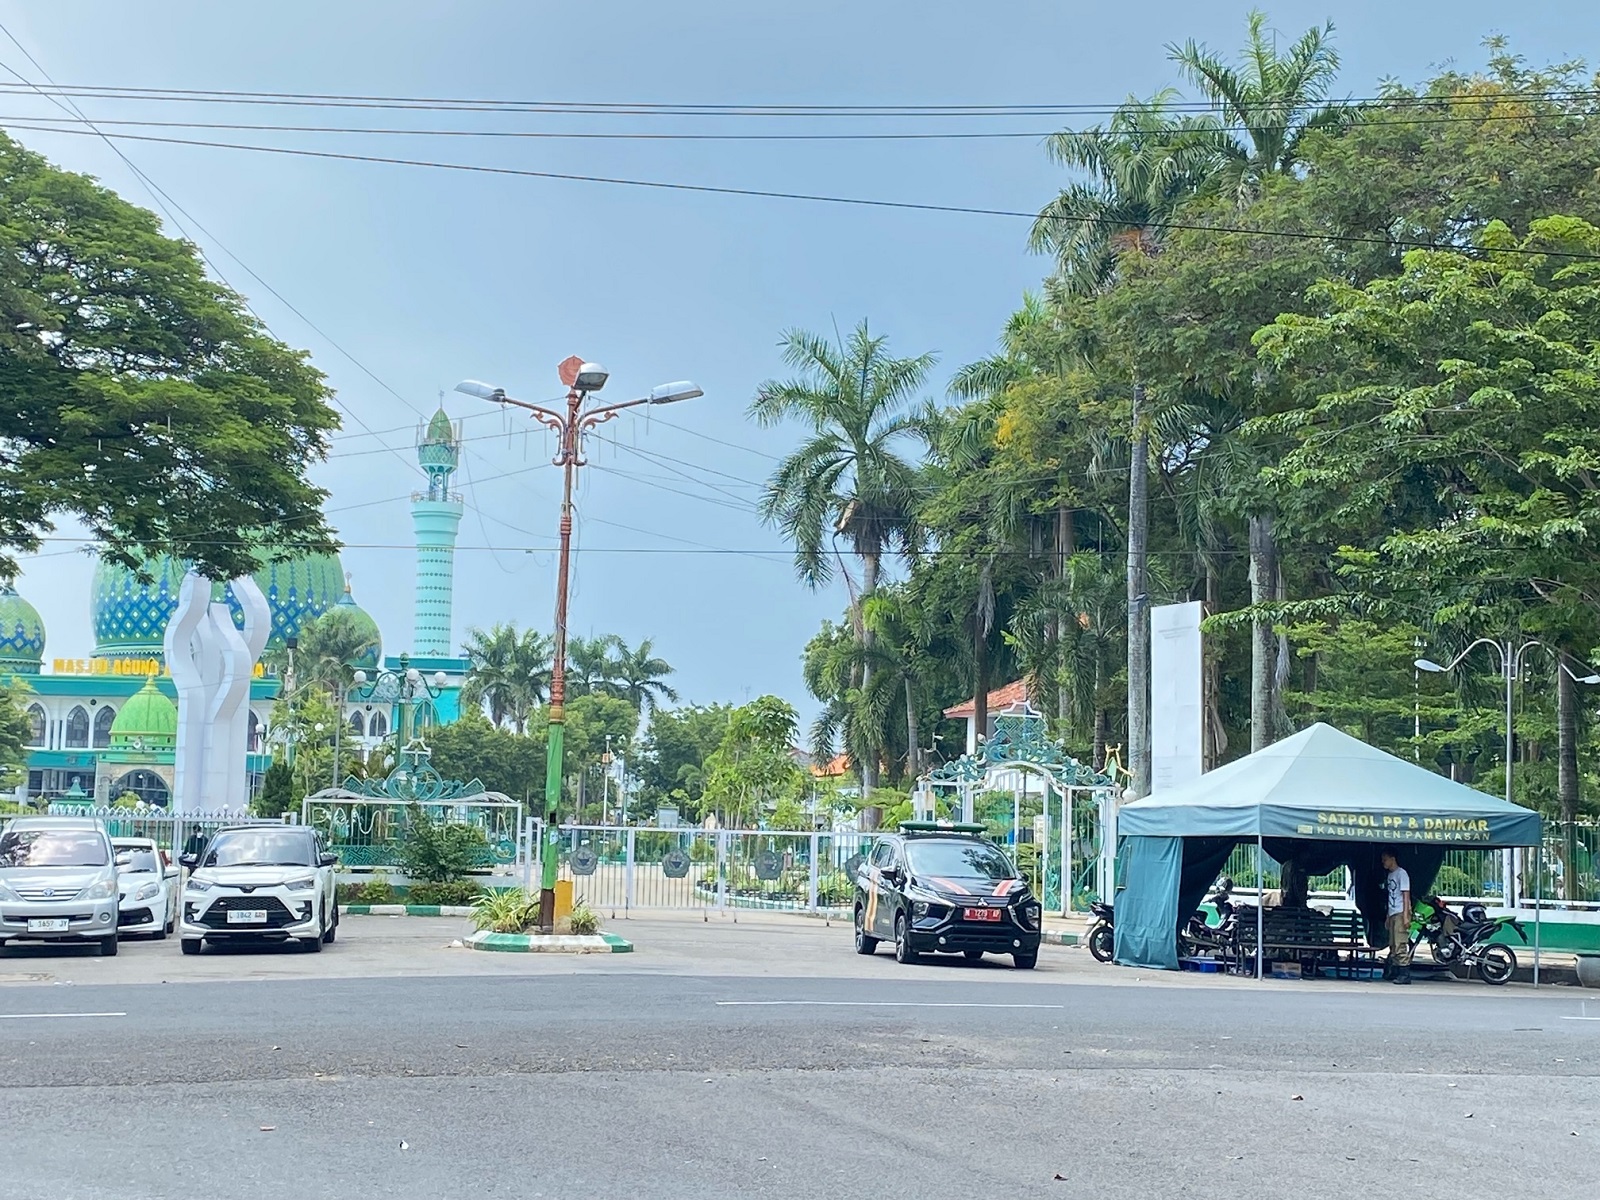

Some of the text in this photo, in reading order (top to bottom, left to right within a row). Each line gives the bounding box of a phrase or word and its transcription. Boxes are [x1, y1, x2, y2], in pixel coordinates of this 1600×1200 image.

[53, 658, 108, 674] MASJID
[1317, 812, 1489, 832] SATPOL PP & DAMKAR
[1317, 825, 1490, 841] KABUPATEN PAMEKASAN
